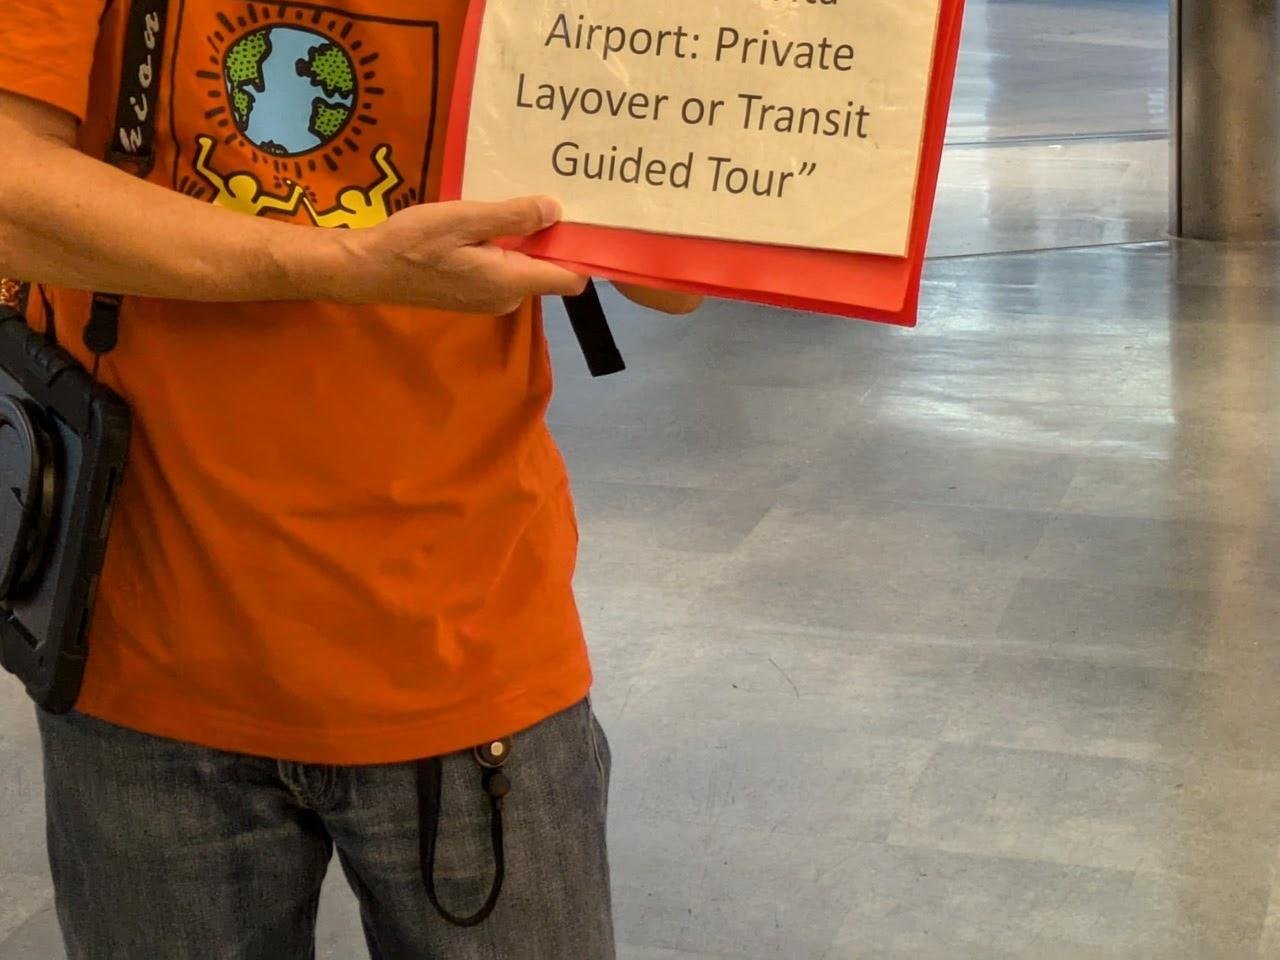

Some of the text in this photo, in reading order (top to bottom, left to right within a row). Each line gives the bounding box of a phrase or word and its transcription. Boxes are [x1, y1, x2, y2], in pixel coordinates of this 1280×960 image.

[544, 13, 855, 71] Airport: Private
[516, 73, 871, 138] Layover or Transit
[551, 141, 694, 190] Guided
